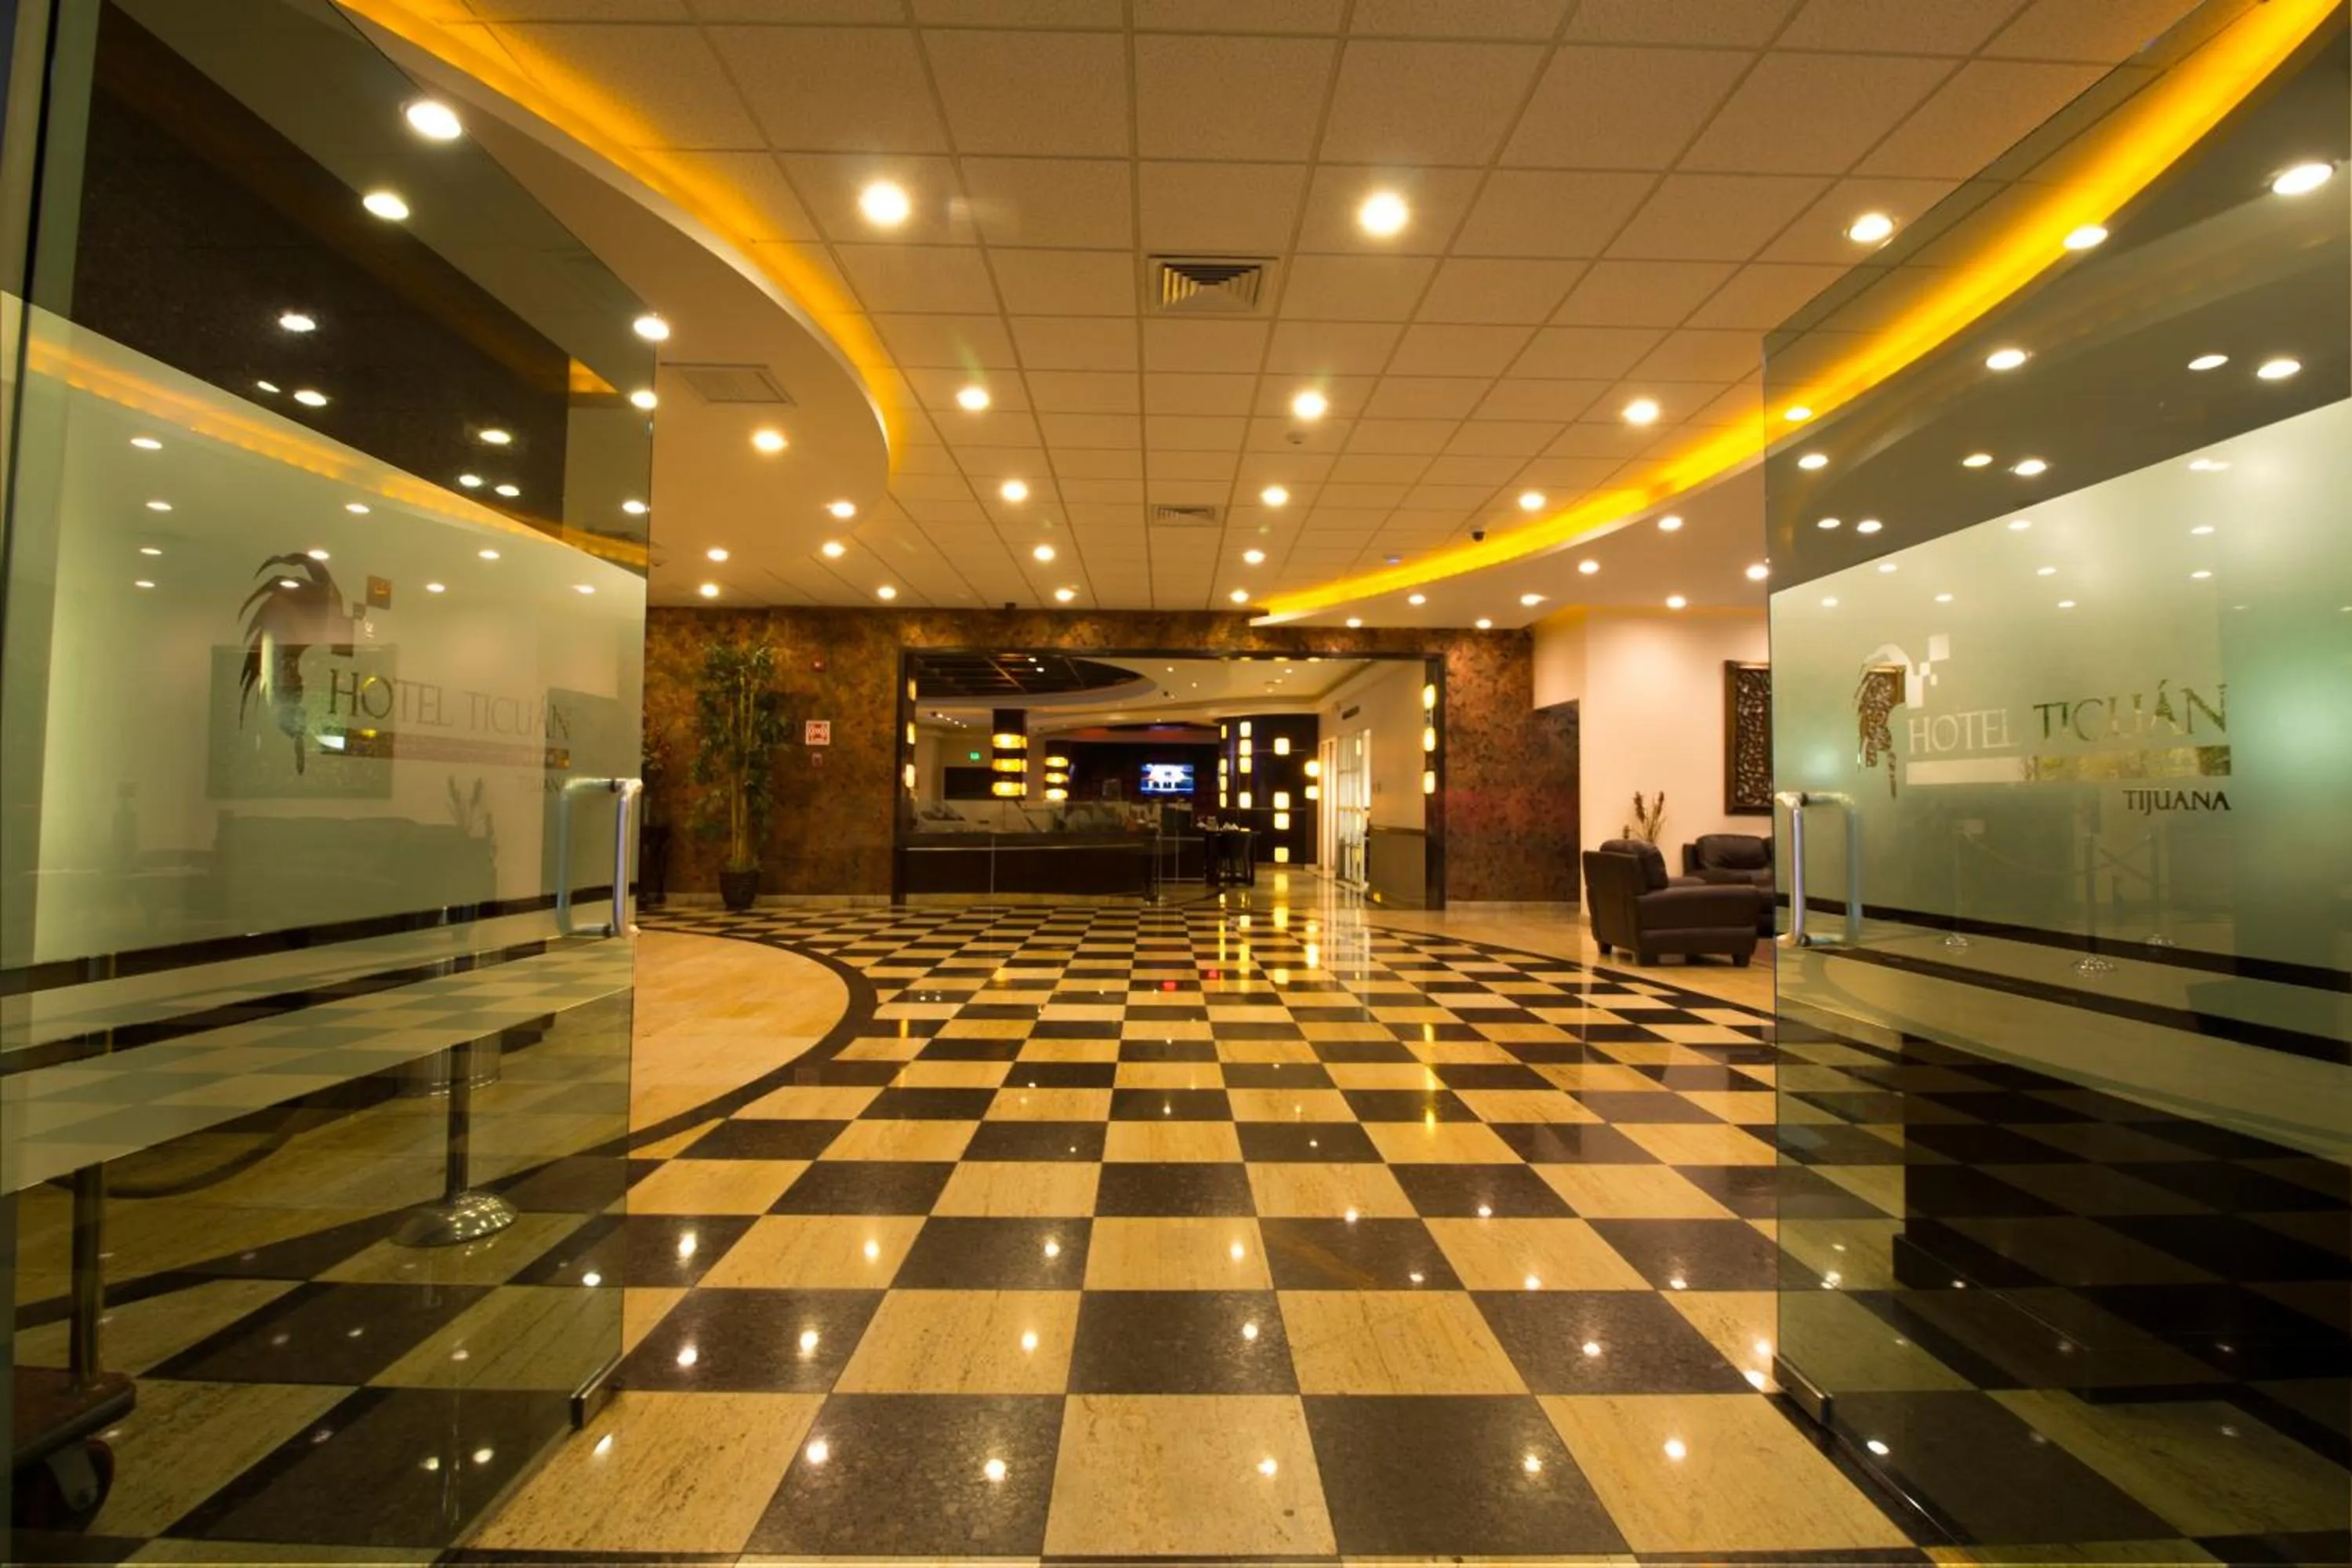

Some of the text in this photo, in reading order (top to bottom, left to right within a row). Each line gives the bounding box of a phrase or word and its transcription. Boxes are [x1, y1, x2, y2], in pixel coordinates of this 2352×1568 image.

[328, 667, 454, 728] HOTEL
[1907, 678, 2229, 754] HOTEL TICUÁN
[2122, 789, 2233, 816] TIJUANA
